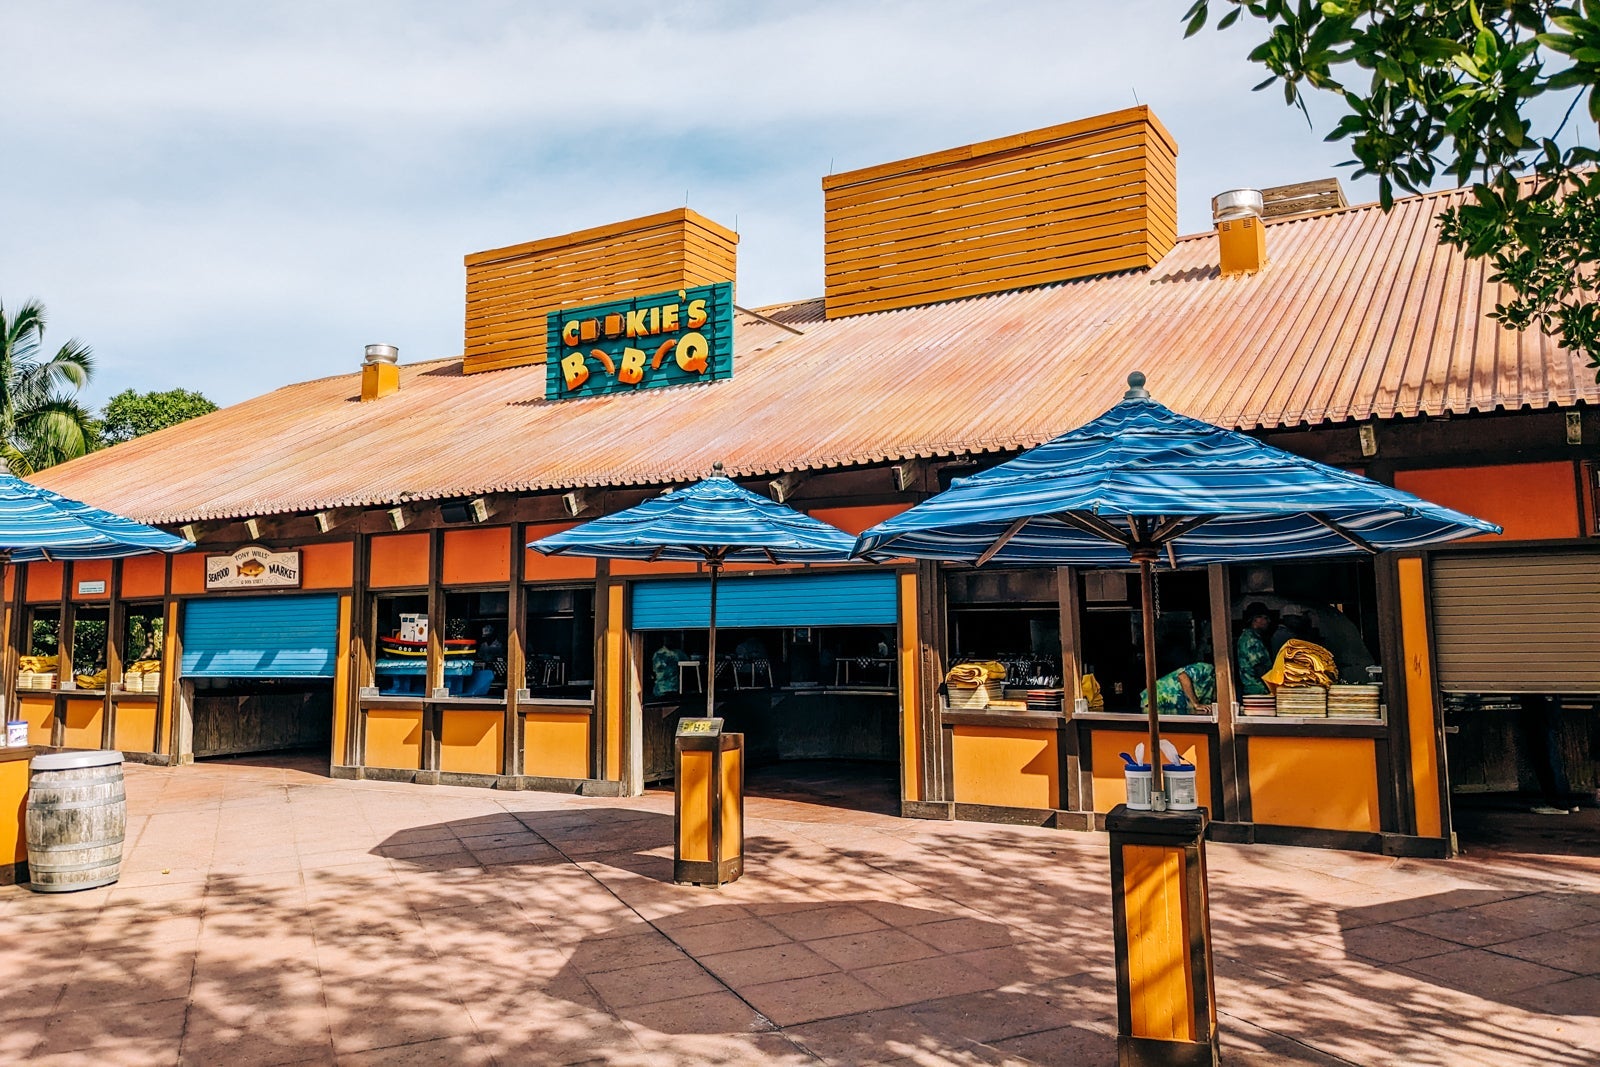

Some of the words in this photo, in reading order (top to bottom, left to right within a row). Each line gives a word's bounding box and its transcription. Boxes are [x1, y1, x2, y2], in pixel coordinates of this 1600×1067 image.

[562, 290, 708, 347] COOKIE'S
[235, 551, 250, 561] TONY
[208, 567, 230, 583] SEAFOOD
[268, 564, 297, 579] MARKET
